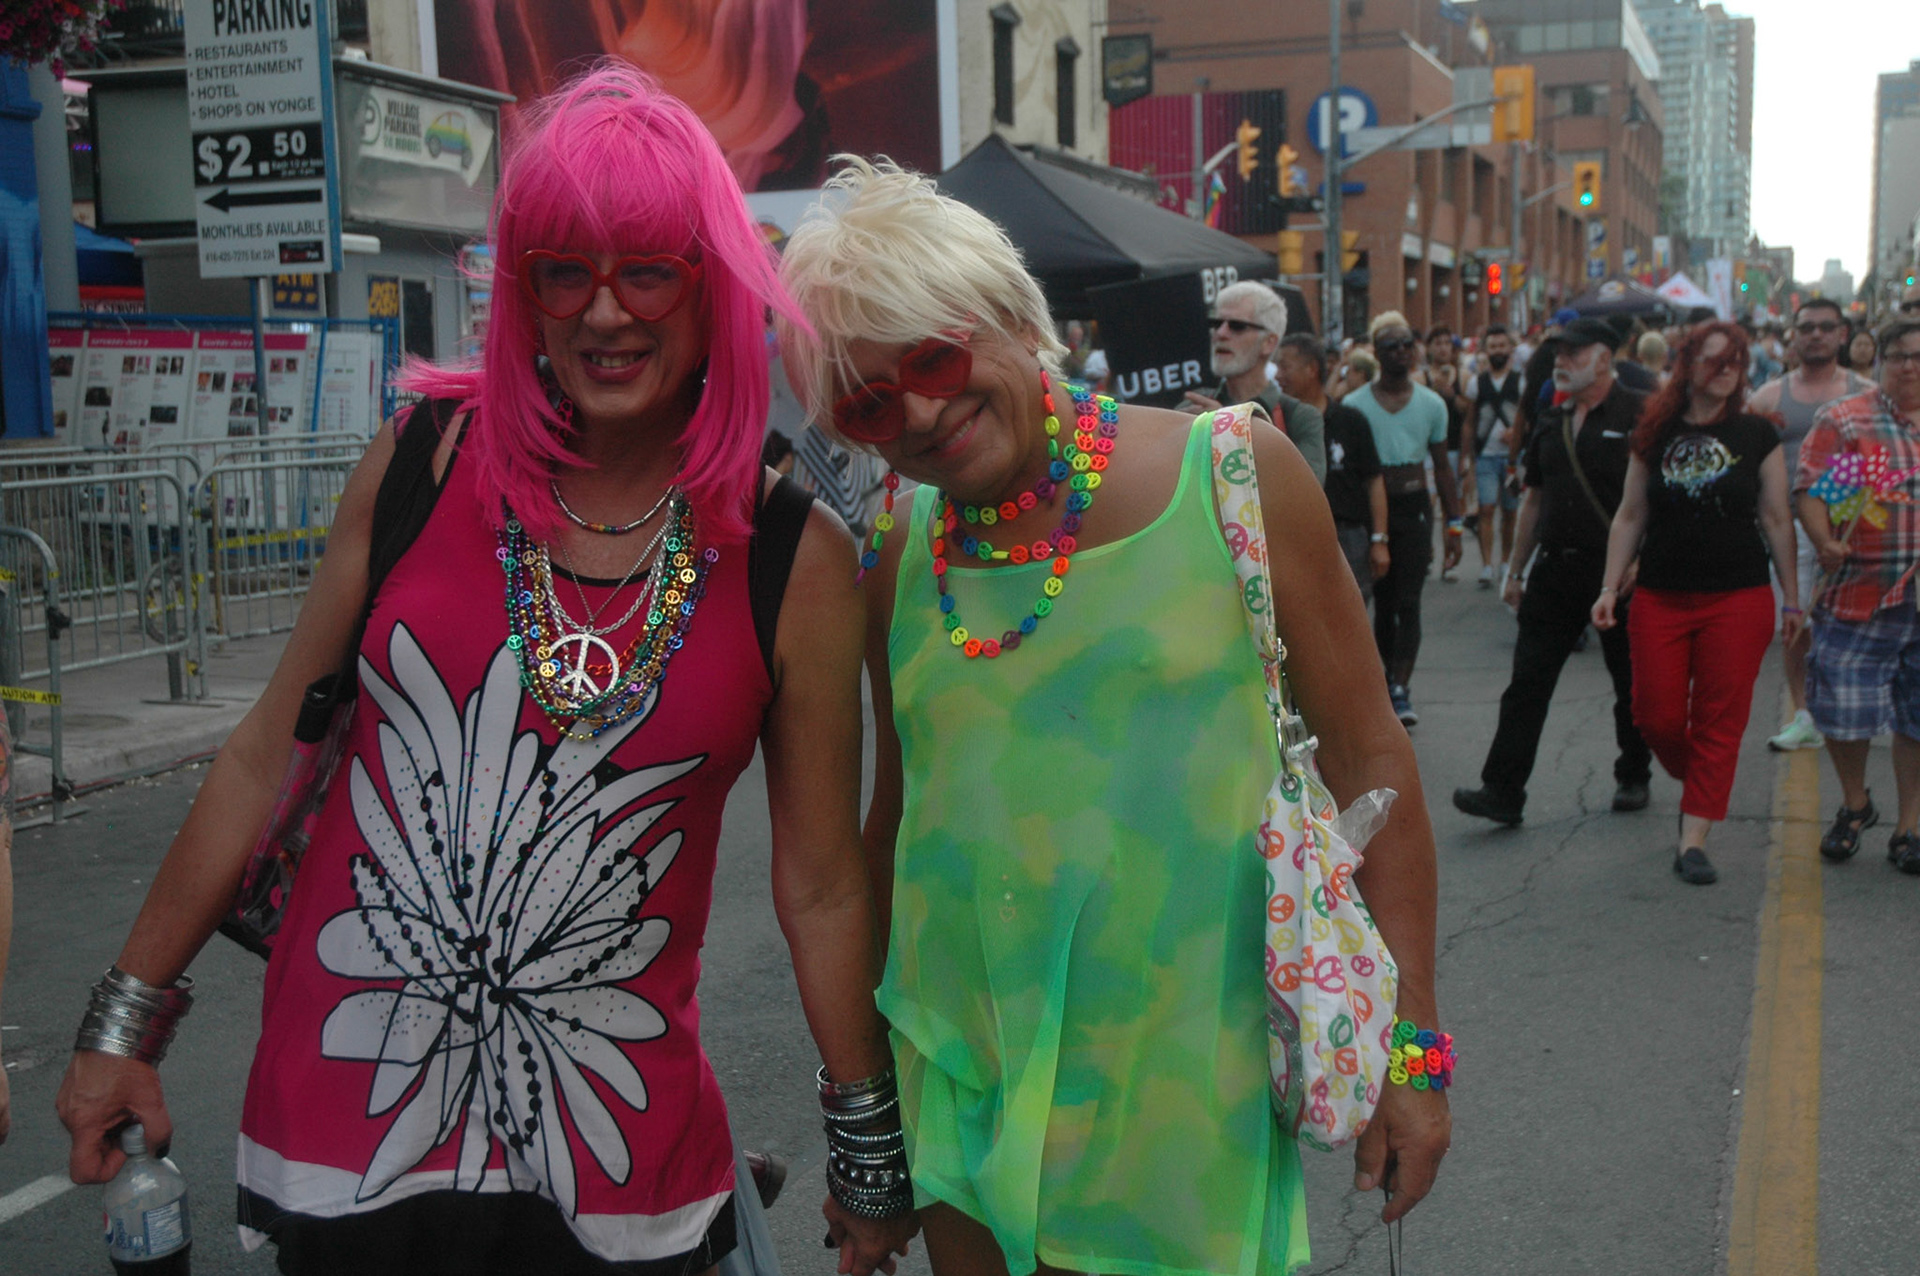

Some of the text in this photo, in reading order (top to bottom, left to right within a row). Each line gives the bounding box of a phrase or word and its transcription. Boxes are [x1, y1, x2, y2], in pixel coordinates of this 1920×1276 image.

[212, 0, 312, 37] PARKING
[195, 40, 288, 60] RESTAURANTS
[196, 58, 303, 80] ENTERTAINMENT
[197, 84, 239, 100] HOTEL
[199, 97, 316, 119] SHOPS ON YONGE
[387, 99, 420, 121] VILLAGE
[384, 115, 422, 138] PARKING
[201, 219, 325, 240] MONTHLIES AVAILABLE
[1117, 359, 1202, 399] UBER
[0, 688, 36, 702] AUTION
